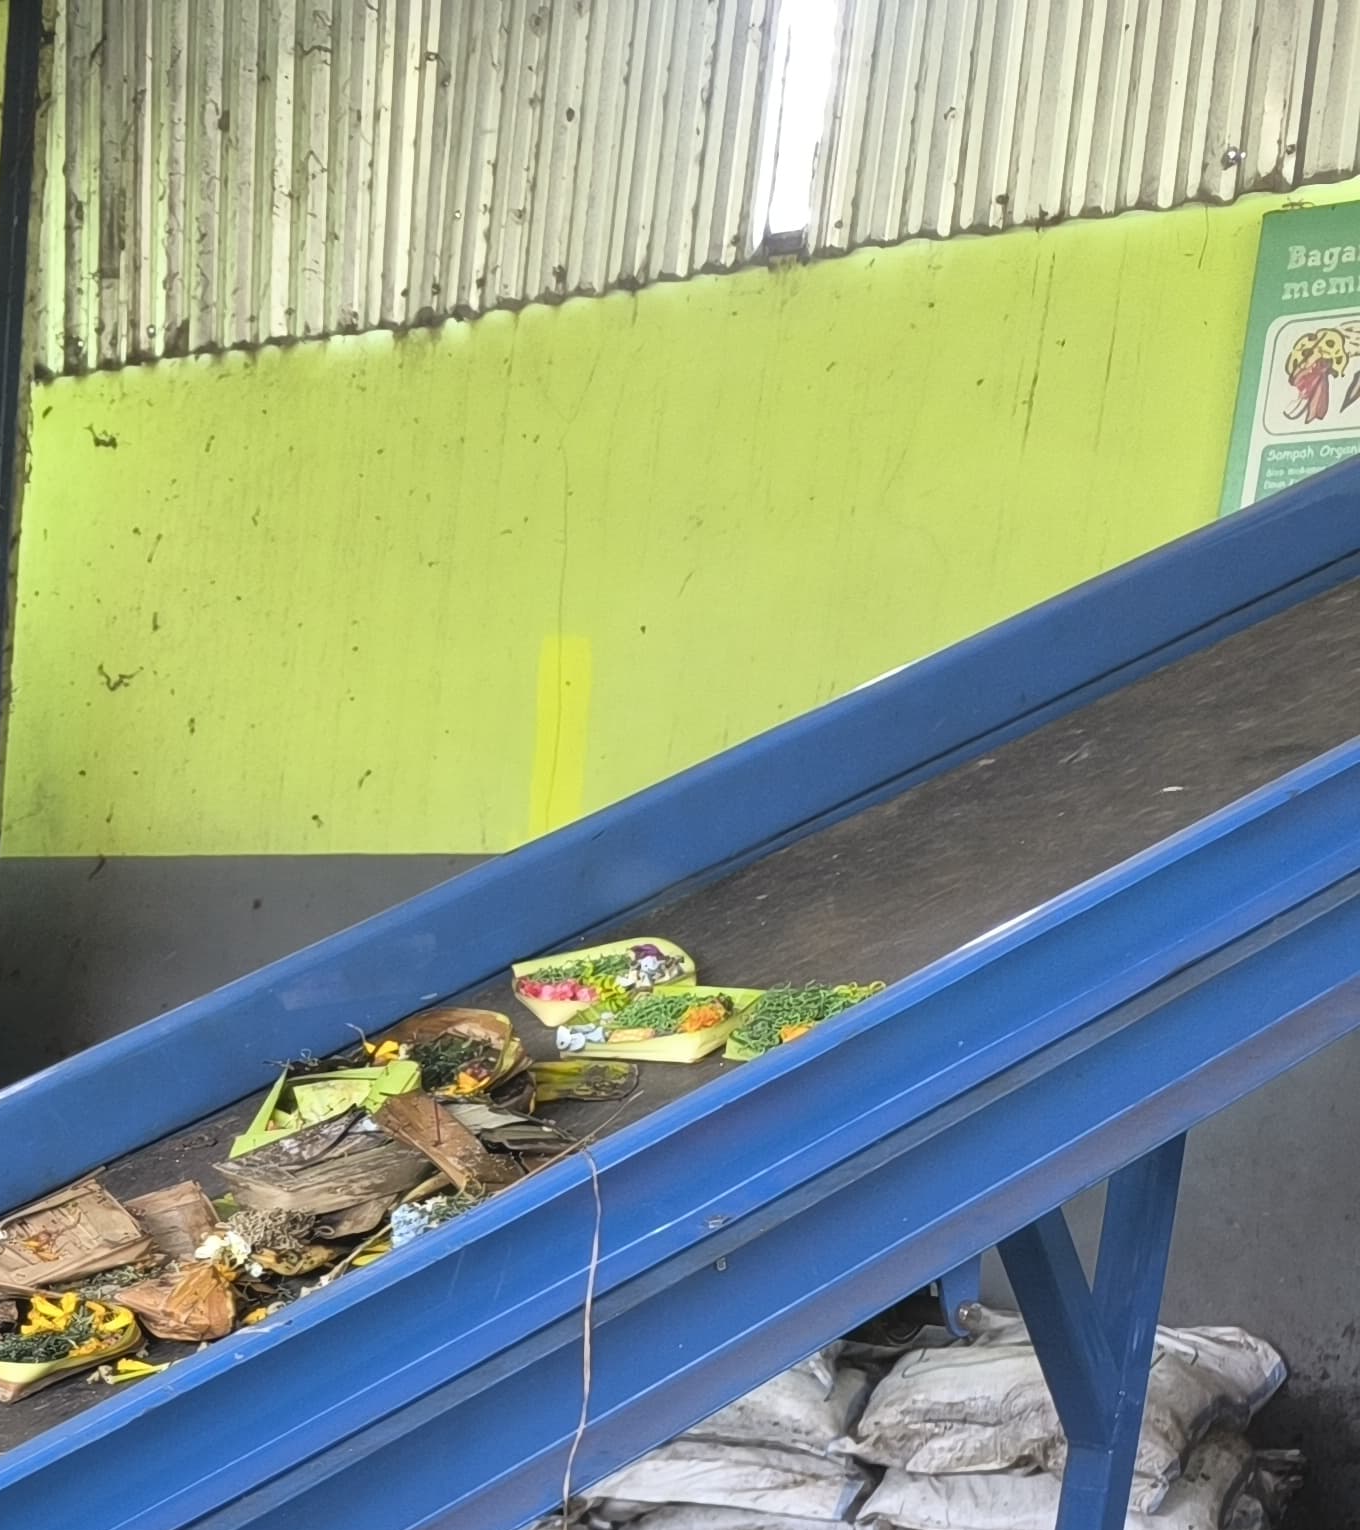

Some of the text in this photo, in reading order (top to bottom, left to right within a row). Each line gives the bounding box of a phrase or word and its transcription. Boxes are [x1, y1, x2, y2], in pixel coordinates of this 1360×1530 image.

[1287, 245, 1360, 273] Baga
[1281, 275, 1360, 301] mem
[1266, 444, 1360, 463] Sampah Organ
